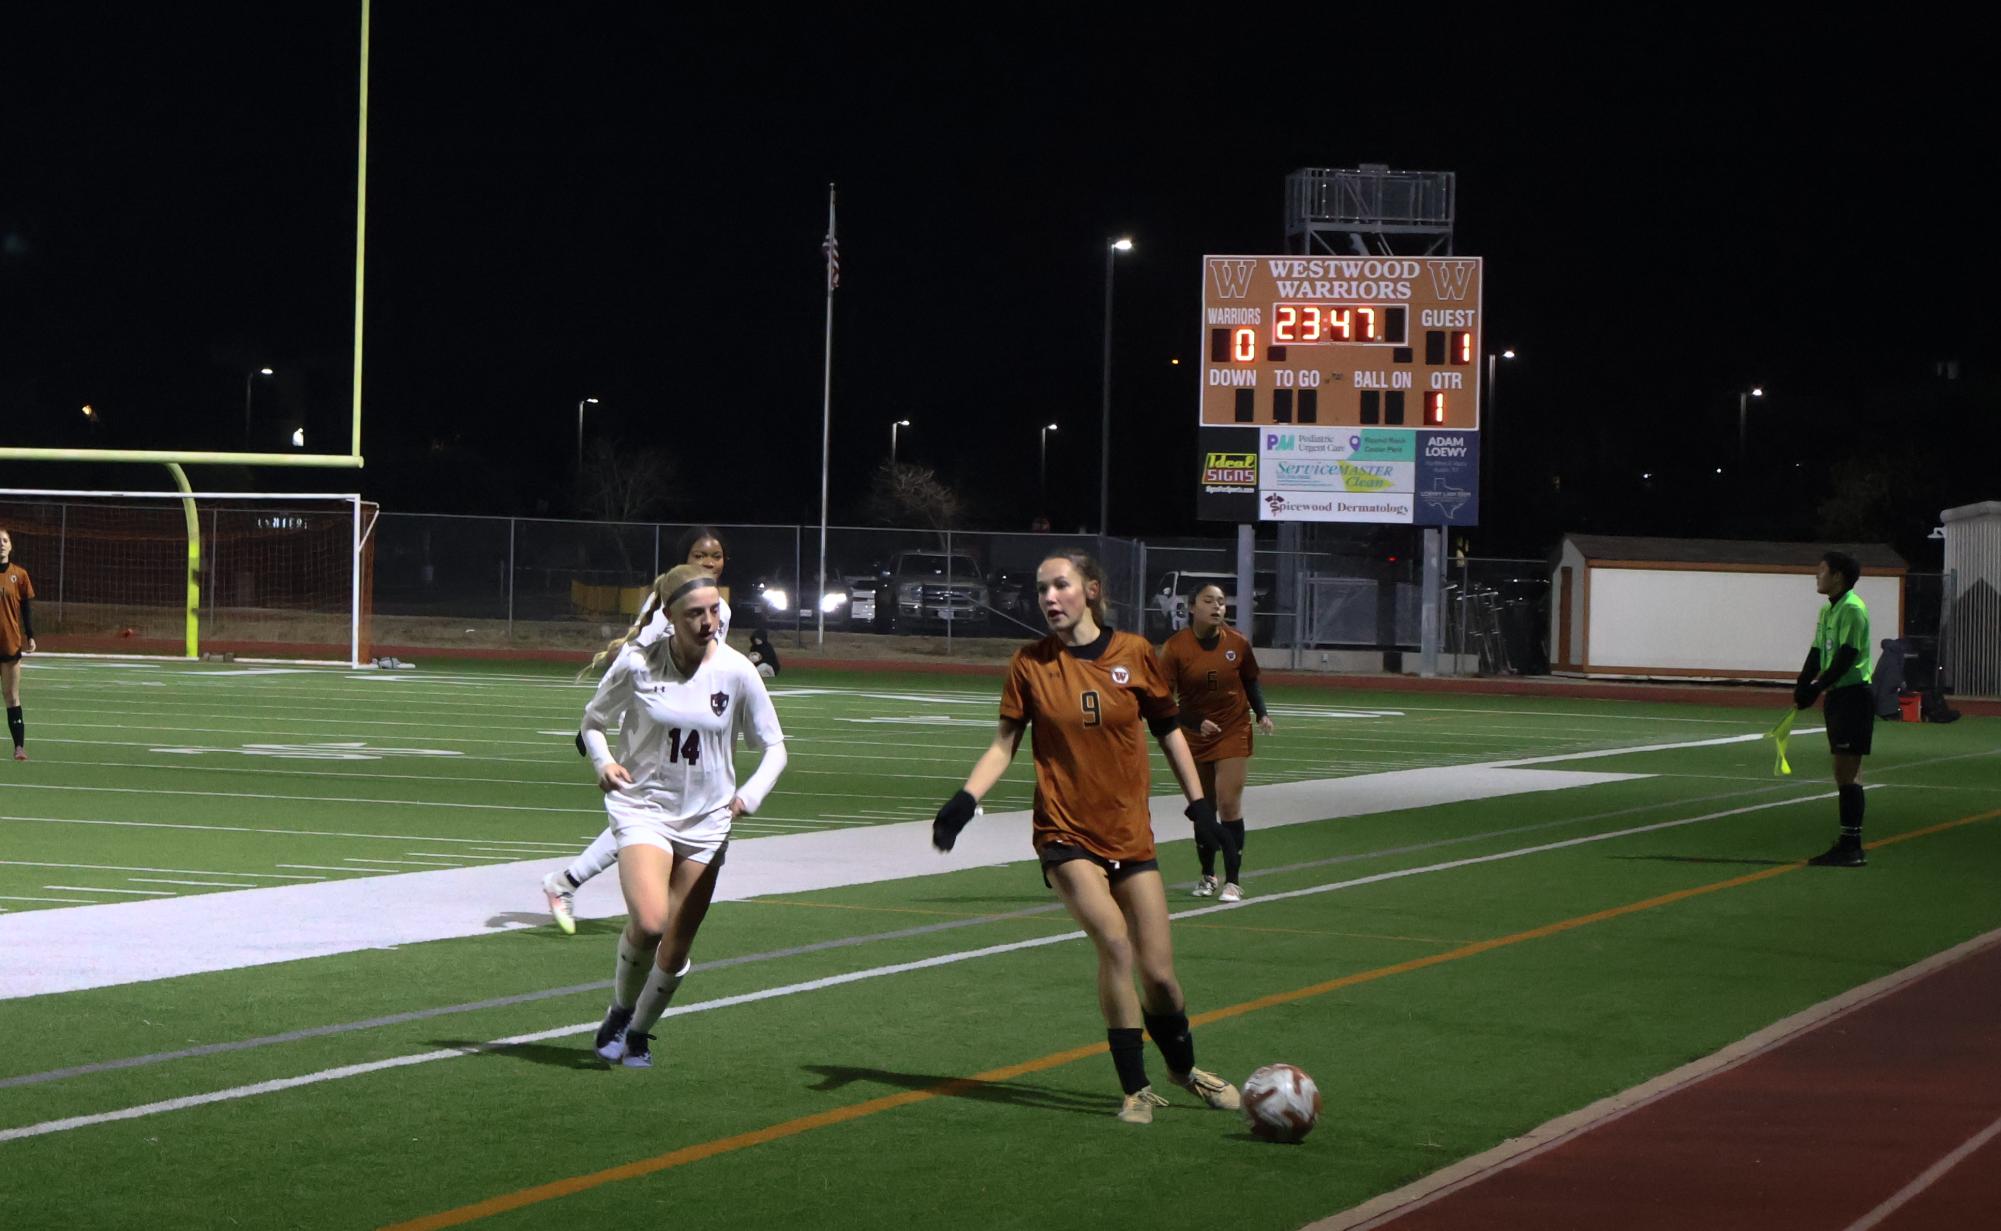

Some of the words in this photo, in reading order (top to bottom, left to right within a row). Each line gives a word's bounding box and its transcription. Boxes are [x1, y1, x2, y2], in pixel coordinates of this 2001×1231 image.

[1269, 260, 1420, 279] WESTWOOD
[1210, 259, 1257, 299] W
[1427, 261, 1476, 300] W
[1276, 280, 1412, 299] WARRIORS
[1208, 308, 1261, 325] WARRIORS
[1421, 309, 1475, 327] GUEST
[1235, 328, 1255, 362] 0
[1462, 332, 1471, 362] 1
[1209, 369, 1257, 387] DOWN
[1274, 370, 1293, 387] TO
[1299, 370, 1320, 387] GO
[1354, 371, 1388, 388] BALL
[1392, 371, 1412, 388] ON
[1431, 372, 1462, 389] QTR
[1435, 392, 1444, 423] 1
[1428, 436, 1464, 447] ADAM
[1425, 447, 1467, 457] LOEWY
[1209, 455, 1255, 469] Ideal
[1345, 476, 1384, 488] Clean
[1270, 501, 1332, 513] Spicewood
[1337, 502, 1409, 516] Dermatology
[1114, 670, 1128, 682] W
[1081, 689, 1102, 728] 9
[668, 727, 700, 766] 14
